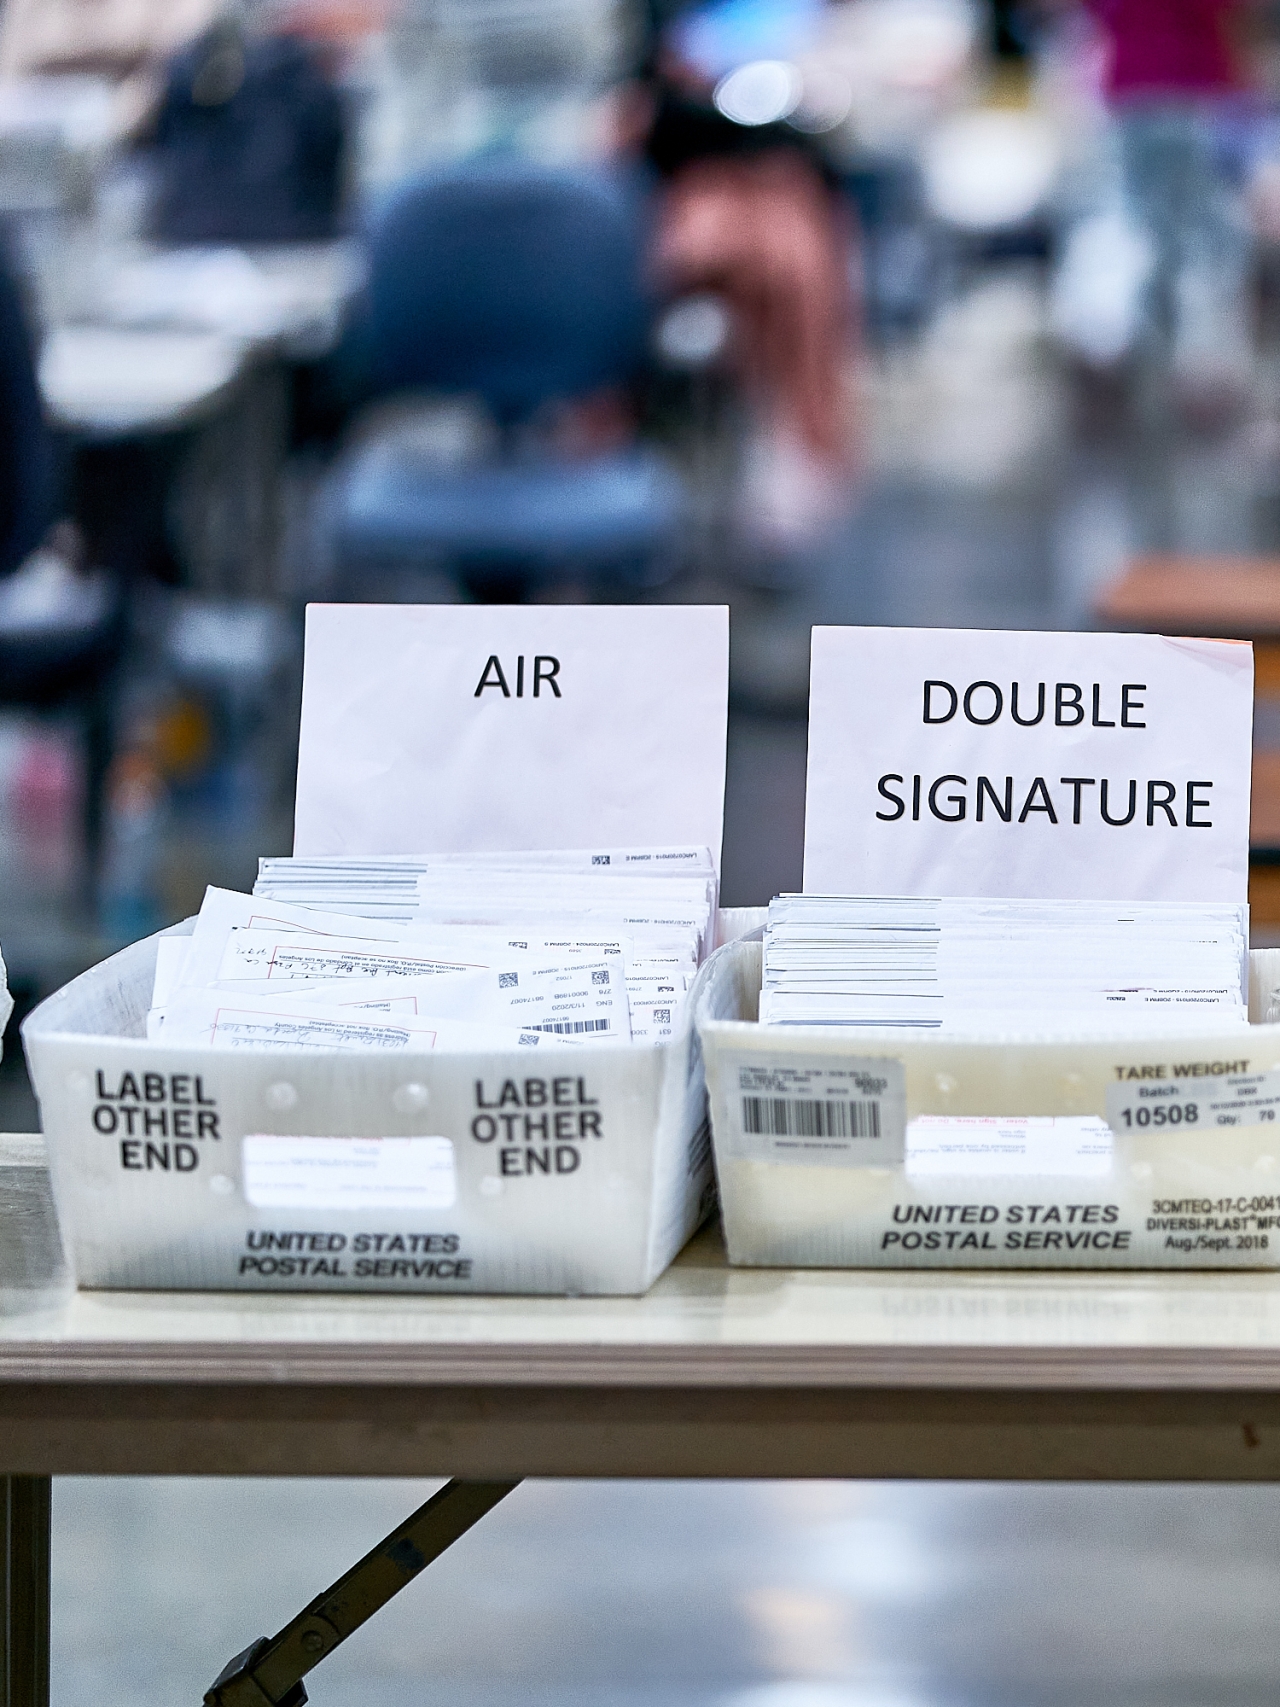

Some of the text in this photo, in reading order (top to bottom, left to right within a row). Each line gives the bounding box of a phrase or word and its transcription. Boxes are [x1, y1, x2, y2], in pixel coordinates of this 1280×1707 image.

[475, 656, 563, 699] AIR
[923, 681, 1148, 730] DOUBLE
[876, 774, 1214, 829] SIGNATURE
[344, 1029, 375, 1037] registered
[1115, 1060, 1250, 1080] TARE WEIGHT
[96, 1069, 216, 1105] LABEL
[476, 1076, 599, 1108] LABEL
[1139, 1086, 1179, 1097] Batch
[93, 1104, 221, 1140] OTHER
[472, 1110, 603, 1143] OTHER
[1121, 1103, 1199, 1127] 10508
[121, 1140, 199, 1171] END
[500, 1145, 581, 1176] END
[893, 1205, 1120, 1224] UNITED STATES
[1153, 1196, 1280, 1214] 3CMTEQ-17-C-0041
[246, 1230, 460, 1253] UNITED STATES
[881, 1230, 1132, 1250] POSTAL SERVICE
[1236, 1235, 1269, 1249] 2018
[238, 1256, 473, 1278] POSTAL SERVICE
